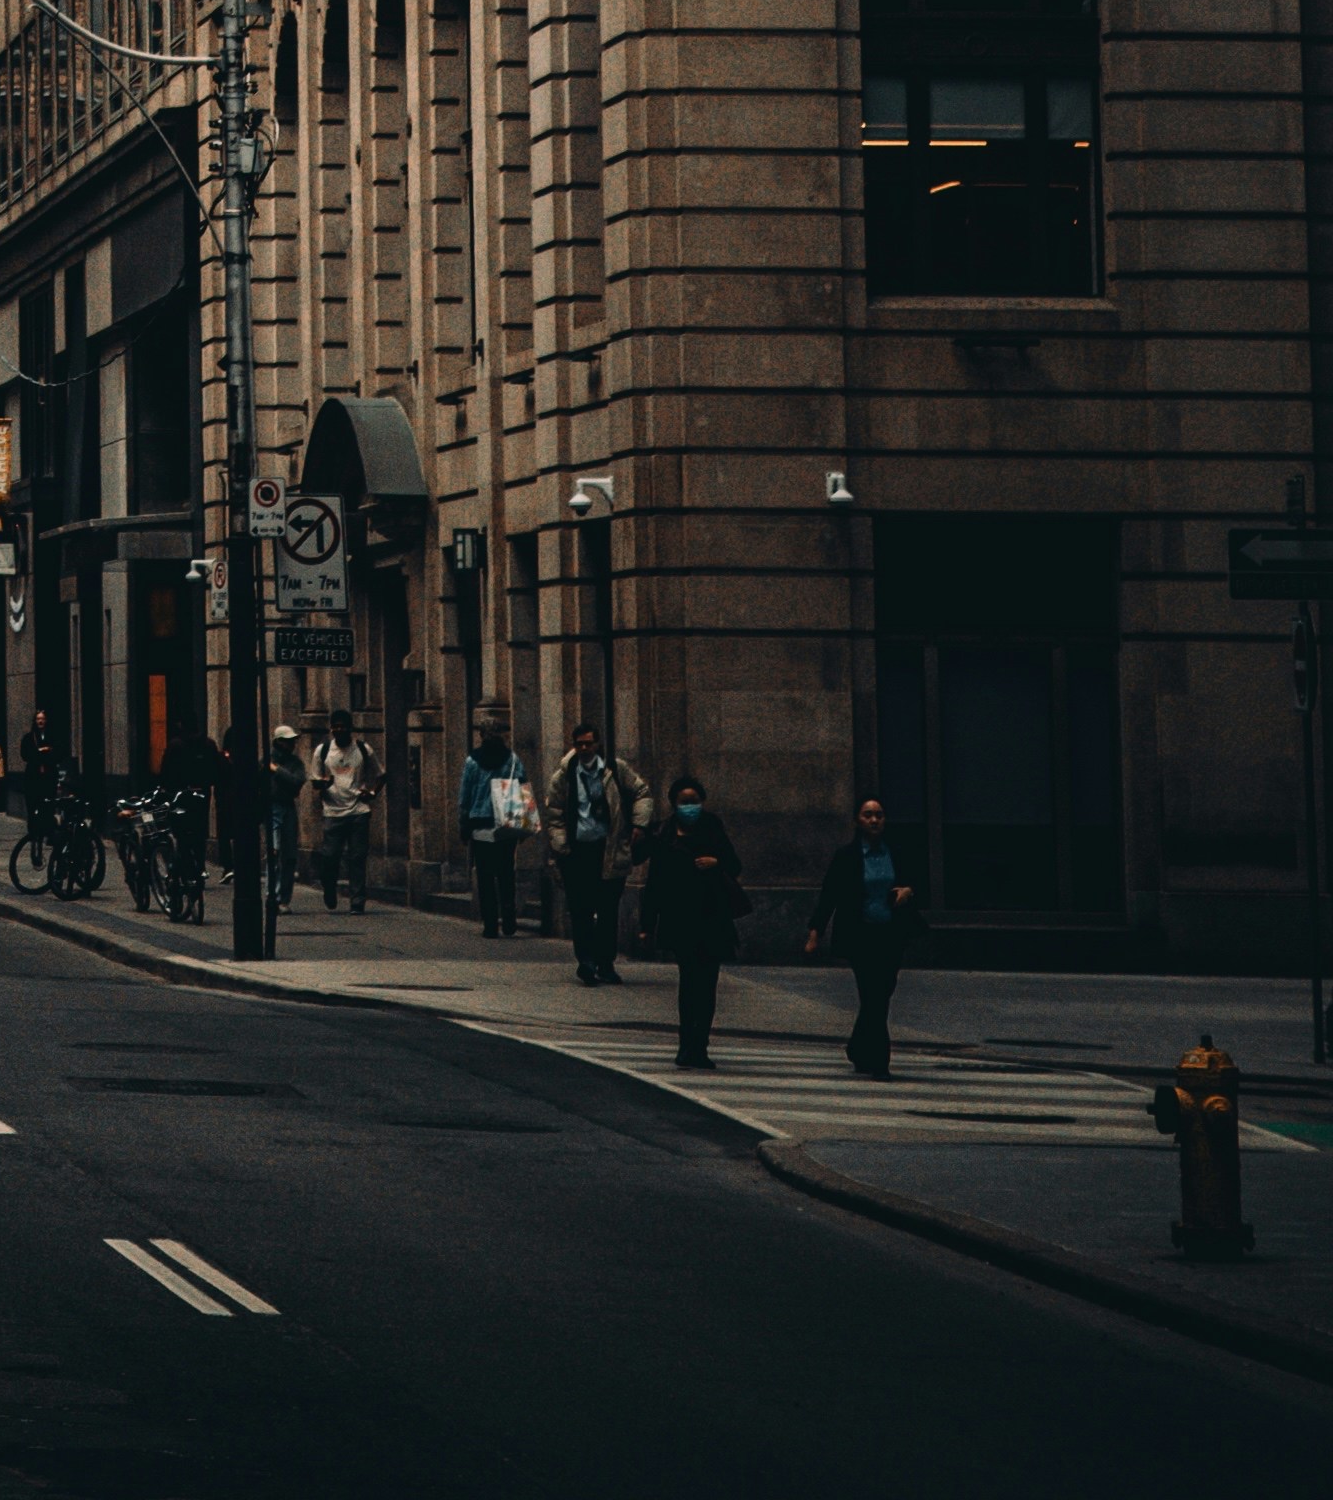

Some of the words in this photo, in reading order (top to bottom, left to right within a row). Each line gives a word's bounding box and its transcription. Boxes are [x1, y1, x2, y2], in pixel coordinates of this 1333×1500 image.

[277, 632, 298, 645] TTC
[303, 633, 353, 646] VEHICLES
[280, 648, 349, 662] EXCEPTED
